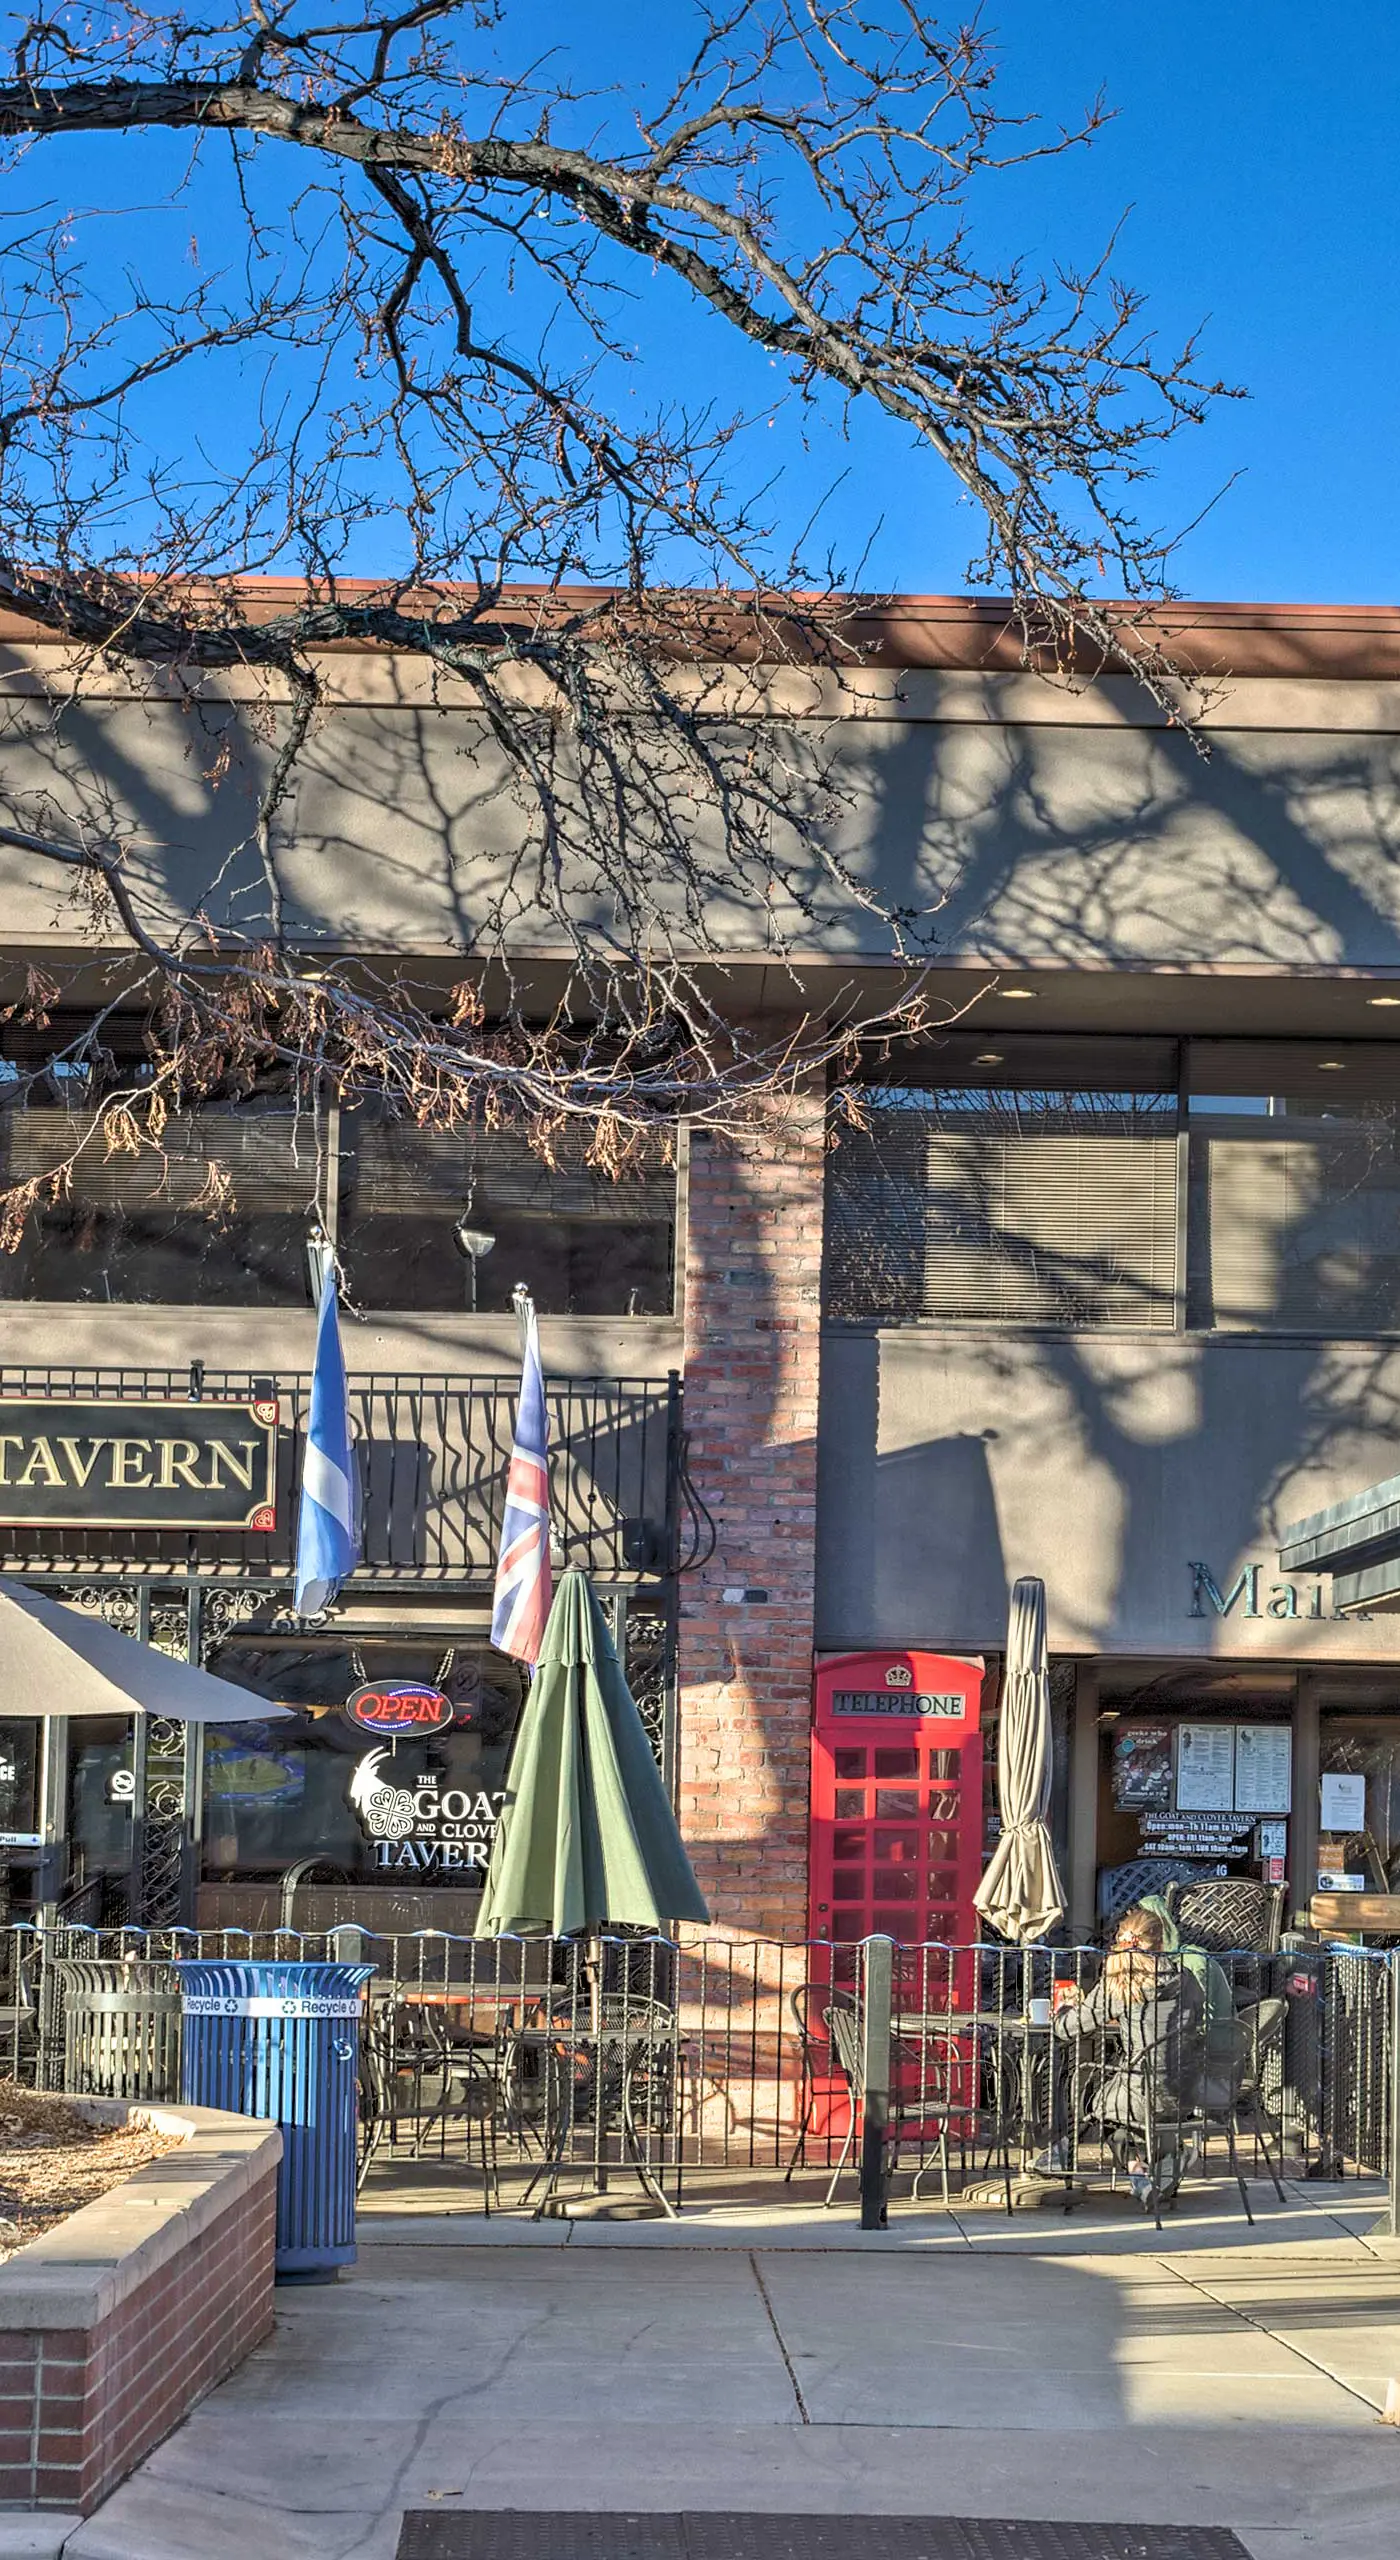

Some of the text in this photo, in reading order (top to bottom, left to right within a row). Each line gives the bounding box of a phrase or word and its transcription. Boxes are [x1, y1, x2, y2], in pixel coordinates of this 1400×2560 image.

[0, 1435, 261, 1491] TAVERN
[1187, 1561, 1374, 1621] Mai
[356, 1693, 444, 1722] OPEN
[835, 1694, 962, 1715] TELEPHONE
[417, 1775, 437, 1785] THE
[1159, 1812, 1180, 1820] GOAT
[1198, 1813, 1227, 1821] CLOVER
[1228, 1814, 1257, 1822] TAVERN
[417, 1823, 436, 1833] AND
[1221, 1823, 1230, 1831] to
[373, 1840, 491, 1869] TAVER
[187, 1999, 221, 2013] Recycle
[302, 2000, 347, 2015] Recycle
